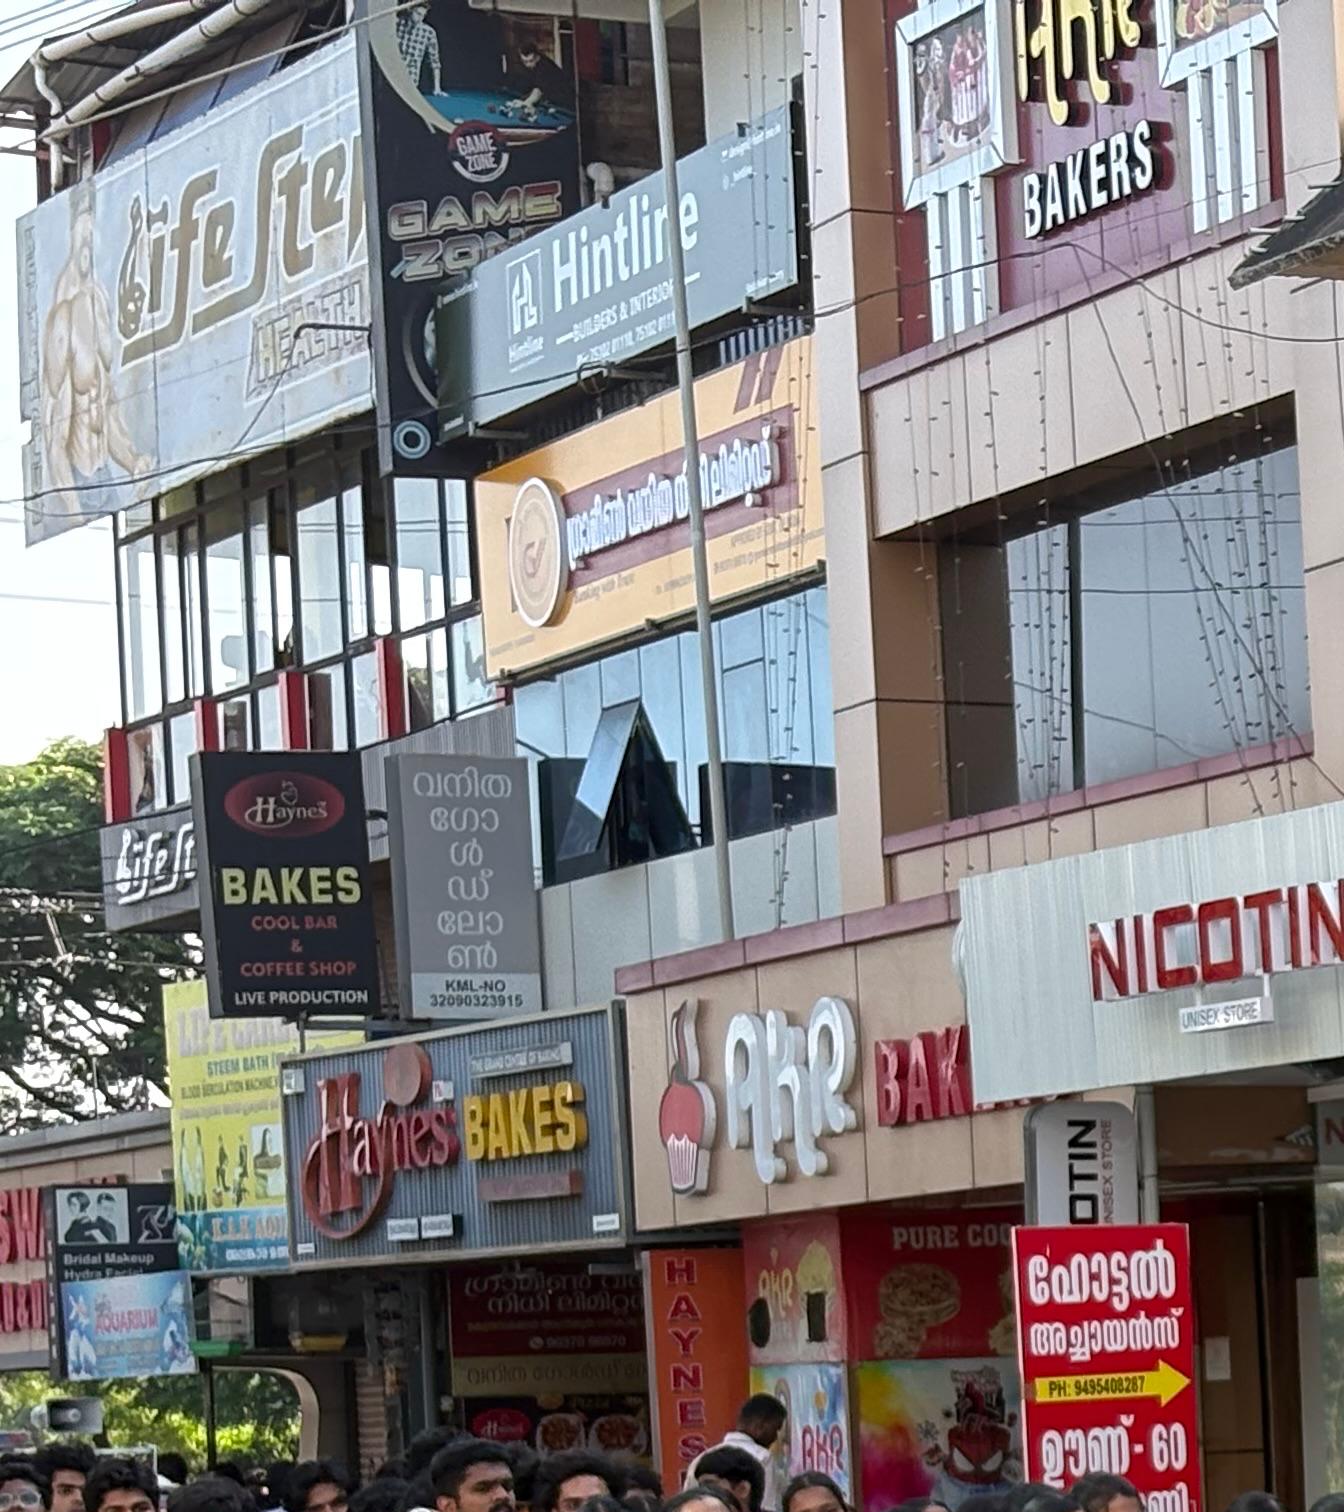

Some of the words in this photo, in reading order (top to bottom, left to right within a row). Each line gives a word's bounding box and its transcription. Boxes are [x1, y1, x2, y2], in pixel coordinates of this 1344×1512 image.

[457, 132, 497, 157] GAME
[465, 152, 498, 172] ZONE
[1023, 119, 1153, 240] BAKERS
[388, 181, 562, 241] GAME
[552, 192, 699, 314] Hintline
[413, 766, 512, 798] വനിത
[244, 795, 328, 830] Haynes
[221, 866, 362, 905] BAKES
[251, 916, 300, 931] COOL
[304, 915, 338, 930] BAR
[291, 938, 303, 953] &
[240, 962, 305, 978] COFFEE
[309, 961, 357, 977] SHOP
[234, 990, 266, 1006] LIVE
[269, 989, 369, 1005] PRODUCTION
[1182, 1008, 1221, 1029] UNISEX
[1223, 1002, 1259, 1024] STORE
[875, 1024, 977, 1127] BAK
[301, 1072, 459, 1241] Haynes
[463, 1081, 582, 1161] BAKES
[1067, 1119, 1099, 1226] OTIN
[1102, 1176, 1113, 1226] NISEX
[893, 1226, 959, 1250] PURE
[64, 1253, 101, 1266] Bridal
[104, 1252, 155, 1266] Makeup
[1028, 1238, 1177, 1312] ഹോട്ടൽ
[1048, 1380, 1071, 1399] PH:
[1151, 1421, 1187, 1472] 60
